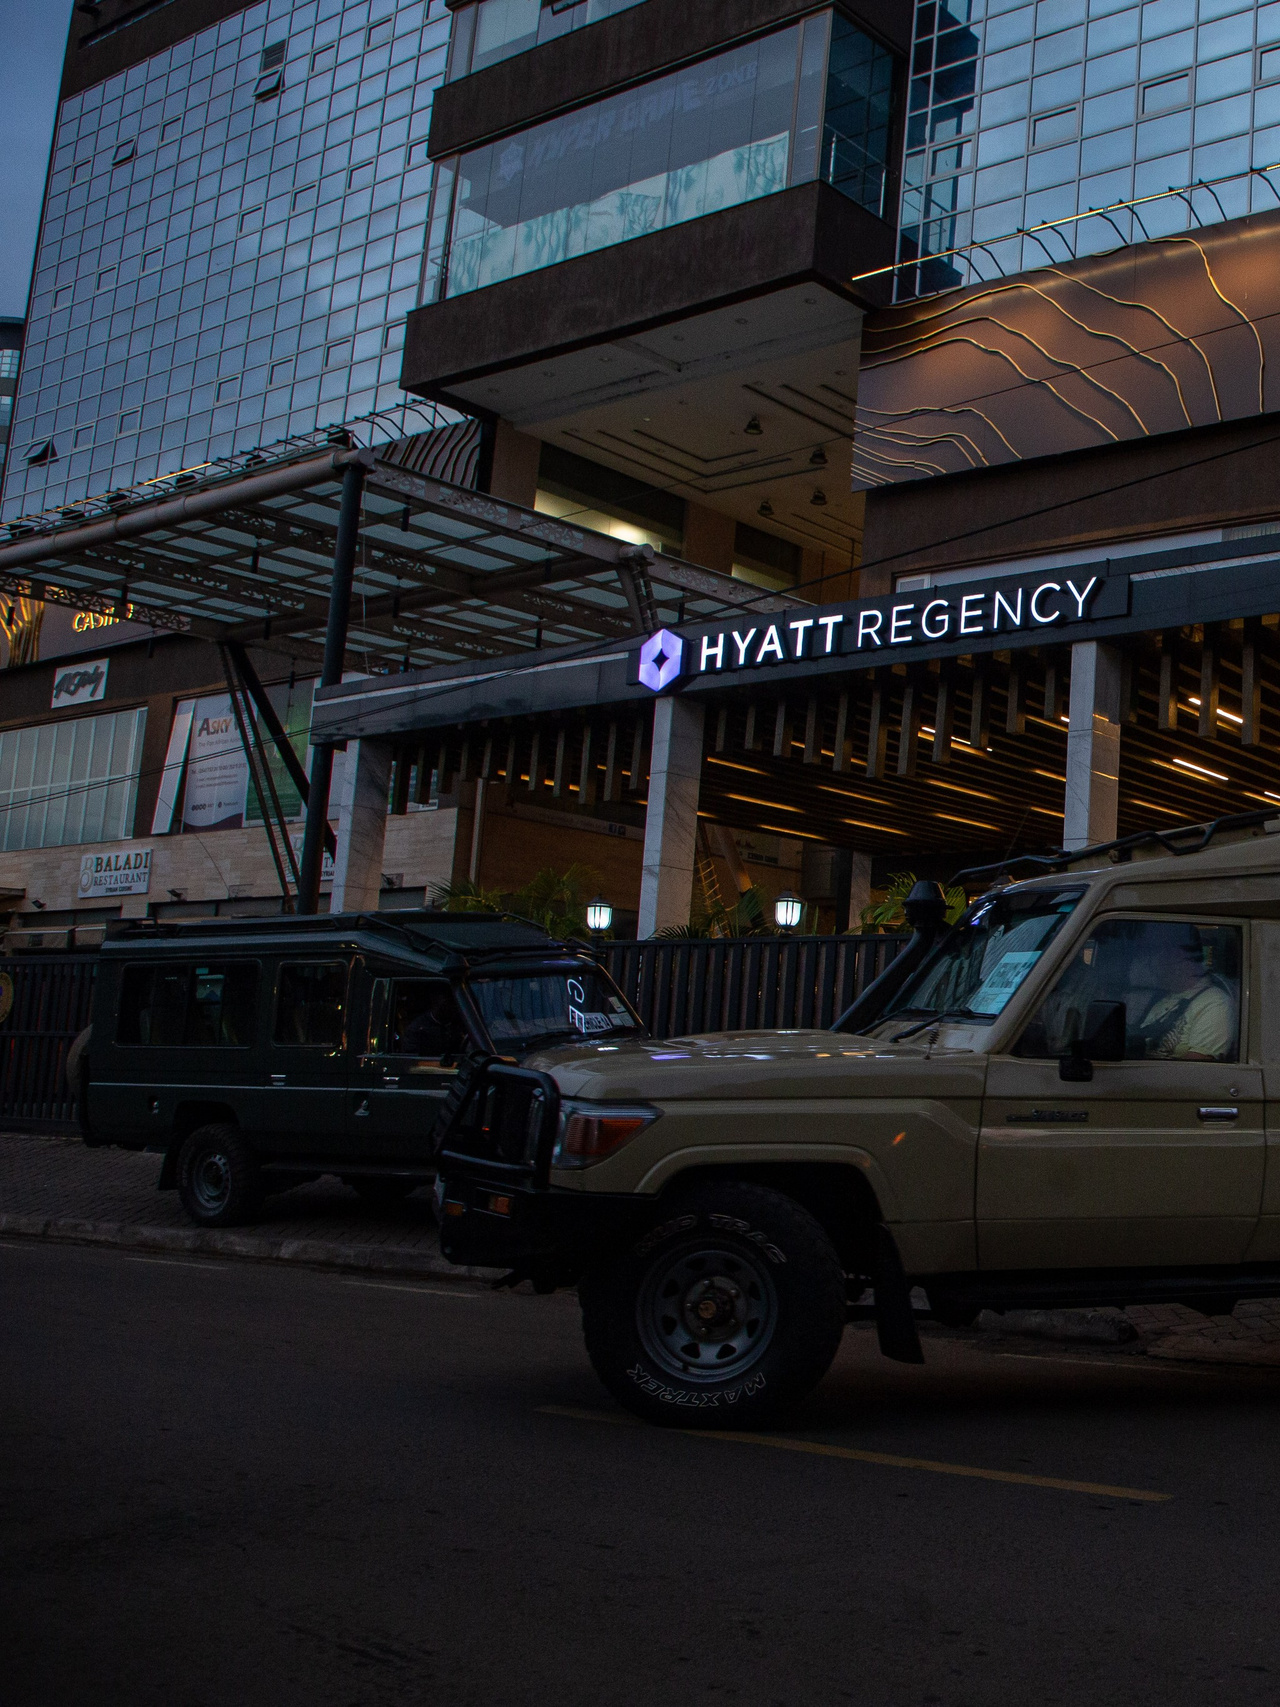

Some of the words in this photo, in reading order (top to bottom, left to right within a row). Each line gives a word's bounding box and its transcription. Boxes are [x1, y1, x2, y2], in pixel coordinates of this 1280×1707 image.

[700, 614, 845, 672] HYATT
[857, 576, 1099, 649] REGENCY
[93, 871, 148, 887] RESTAURANT
[94, 852, 150, 873] BALADI
[626, 1363, 767, 1408] MAXTREK
